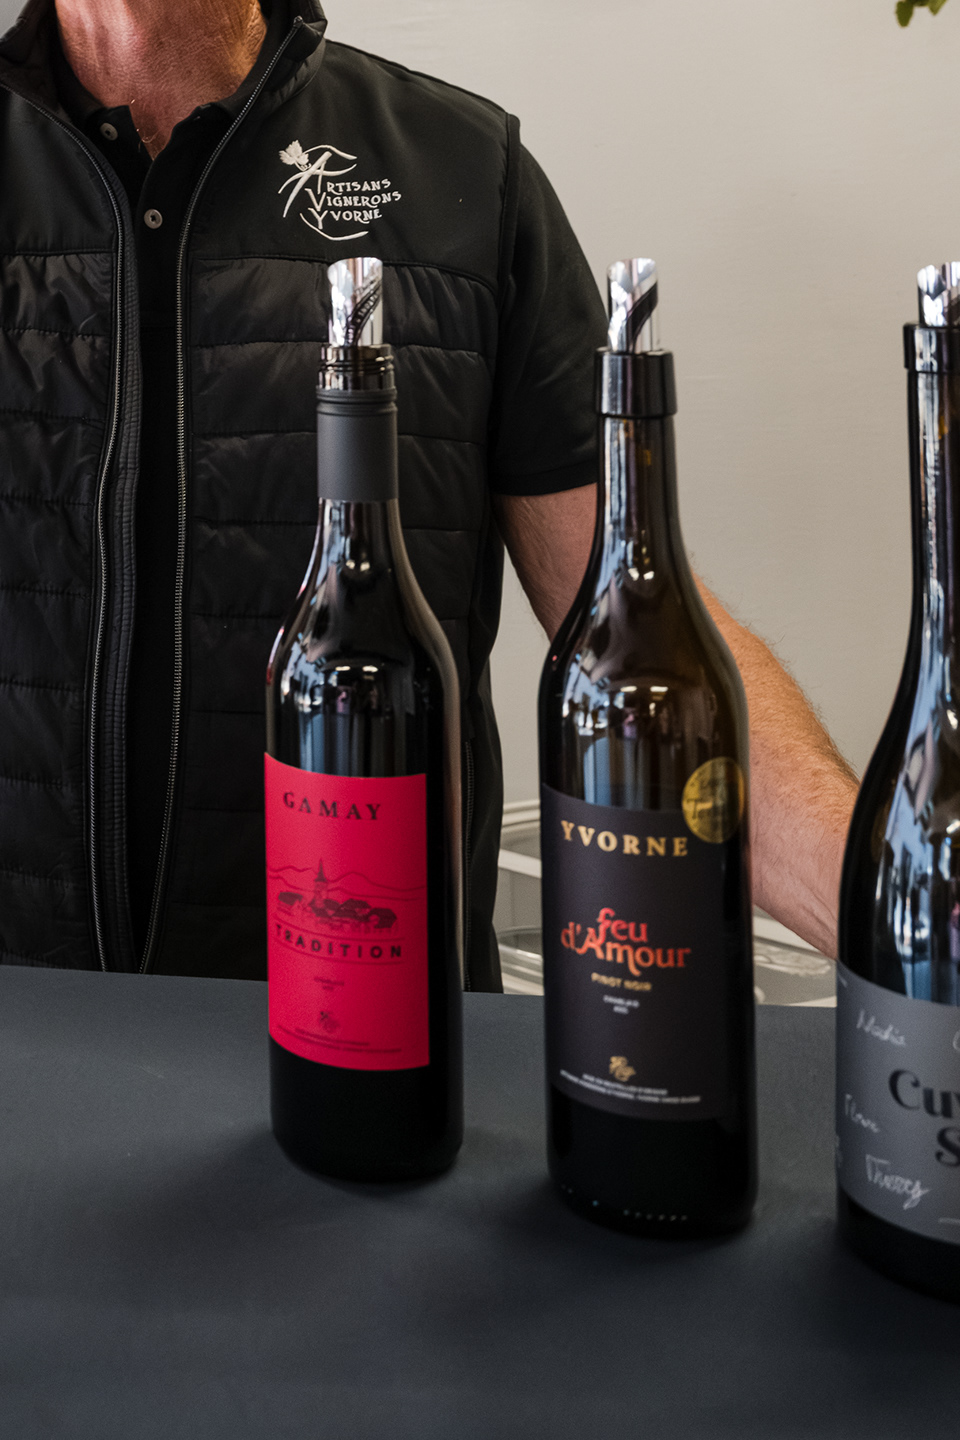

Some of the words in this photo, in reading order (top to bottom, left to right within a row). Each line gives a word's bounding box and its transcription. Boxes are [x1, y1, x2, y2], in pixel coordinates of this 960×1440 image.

[305, 188, 402, 213] VIGNERONS
[308, 207, 383, 229] YVORNE
[282, 791, 382, 821] GAMAY
[560, 820, 689, 857] YVORNE
[275, 923, 402, 959] TRADITION
[560, 921, 691, 976] d'Amour
[591, 971, 622, 988] PINOT
[624, 978, 652, 991] NOIR
[888, 1068, 960, 1120] Cu
